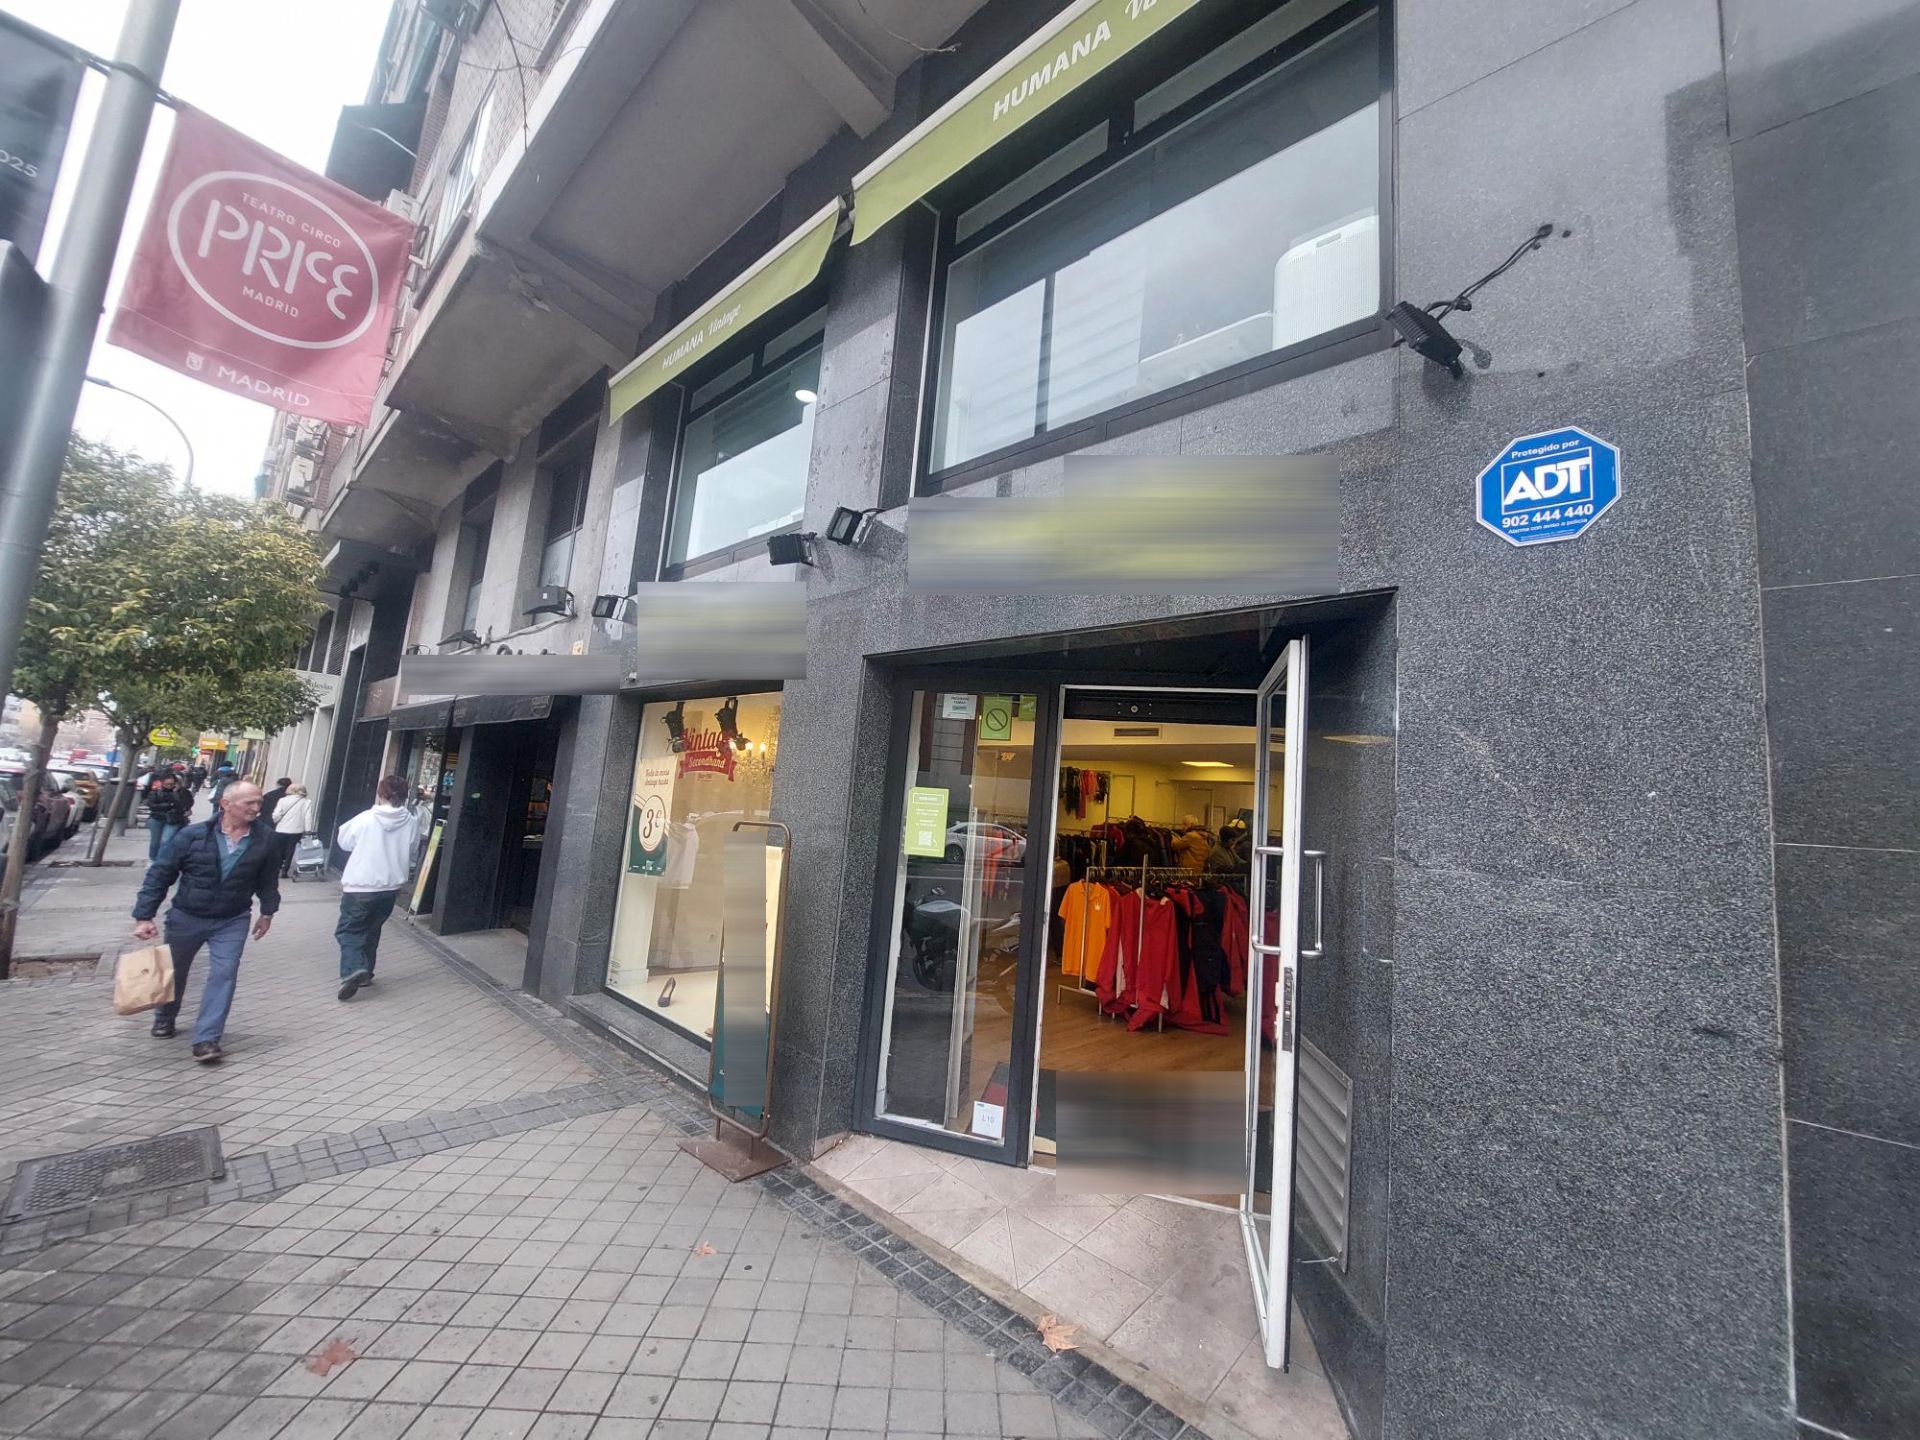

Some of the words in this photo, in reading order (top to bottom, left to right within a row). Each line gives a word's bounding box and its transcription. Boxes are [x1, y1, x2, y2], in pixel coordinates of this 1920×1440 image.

[993, 20, 1112, 122] HUMANA
[242, 192, 296, 225] TEATRO
[301, 222, 342, 248] CIRCO
[197, 199, 359, 320] PRICE
[242, 285, 300, 318] MADRID
[662, 330, 704, 370] HUMANA
[217, 365, 311, 406] MADRID
[1511, 443, 1560, 459] Protegido
[1562, 439, 1580, 450] por
[1503, 457, 1591, 505] ADT
[1502, 514, 1529, 528] 902
[1532, 509, 1561, 523] 444
[1564, 504, 1594, 517] 440
